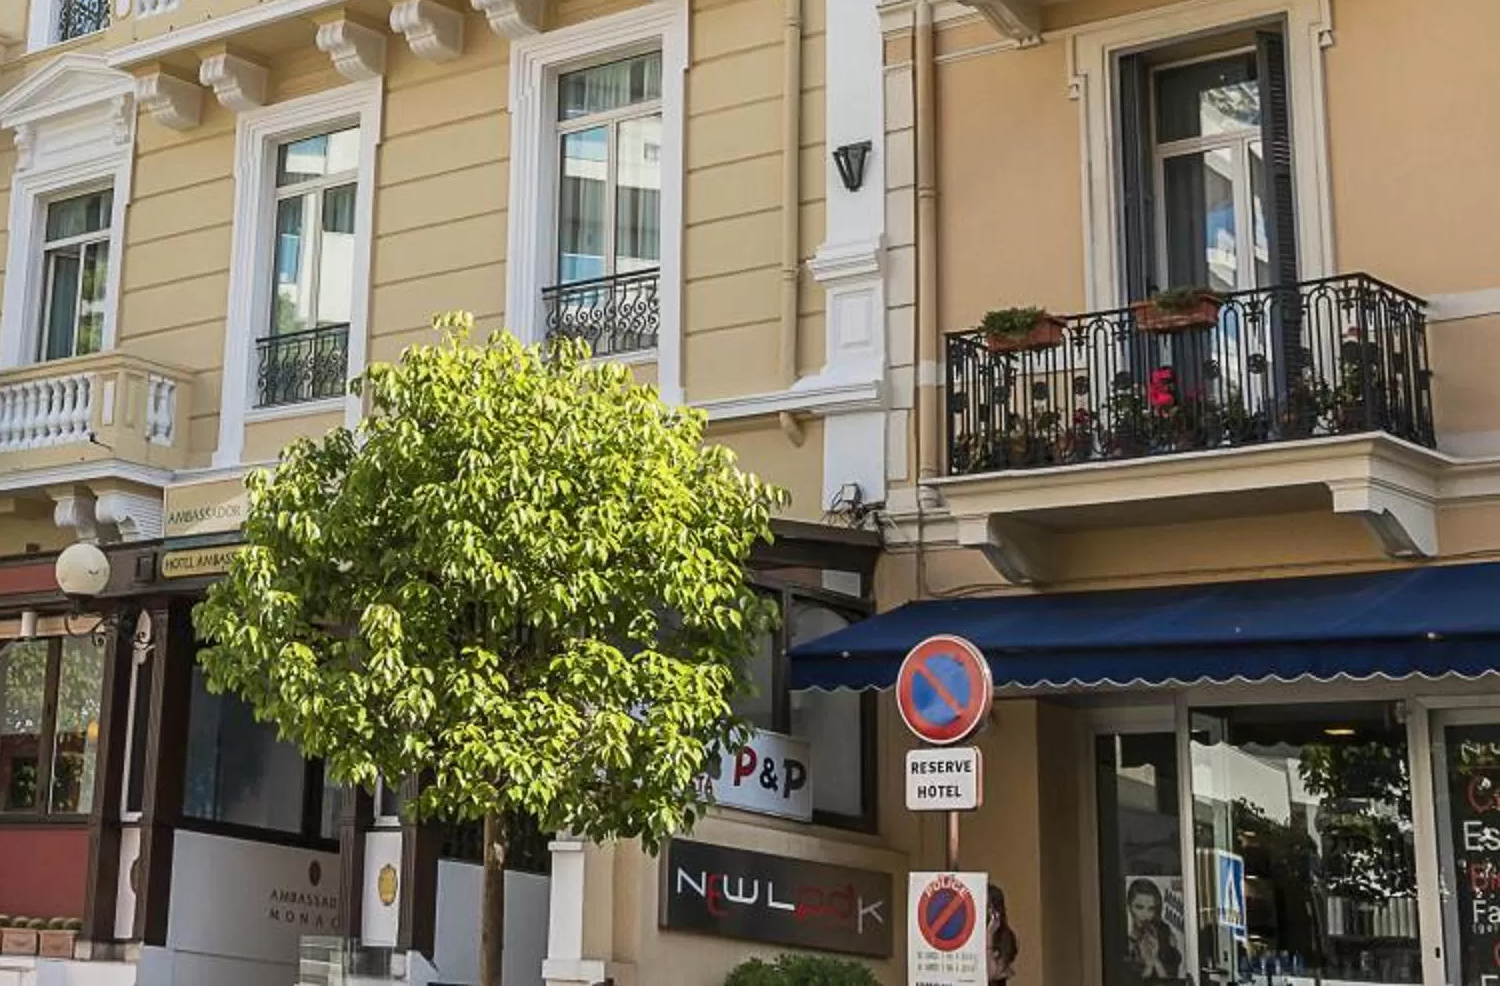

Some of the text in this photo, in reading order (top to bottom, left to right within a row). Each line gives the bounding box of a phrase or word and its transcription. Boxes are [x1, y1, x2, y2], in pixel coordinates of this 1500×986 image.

[164, 555, 195, 571] HOTEL
[911, 760, 972, 774] RESERVE
[917, 785, 962, 798] HOTEL
